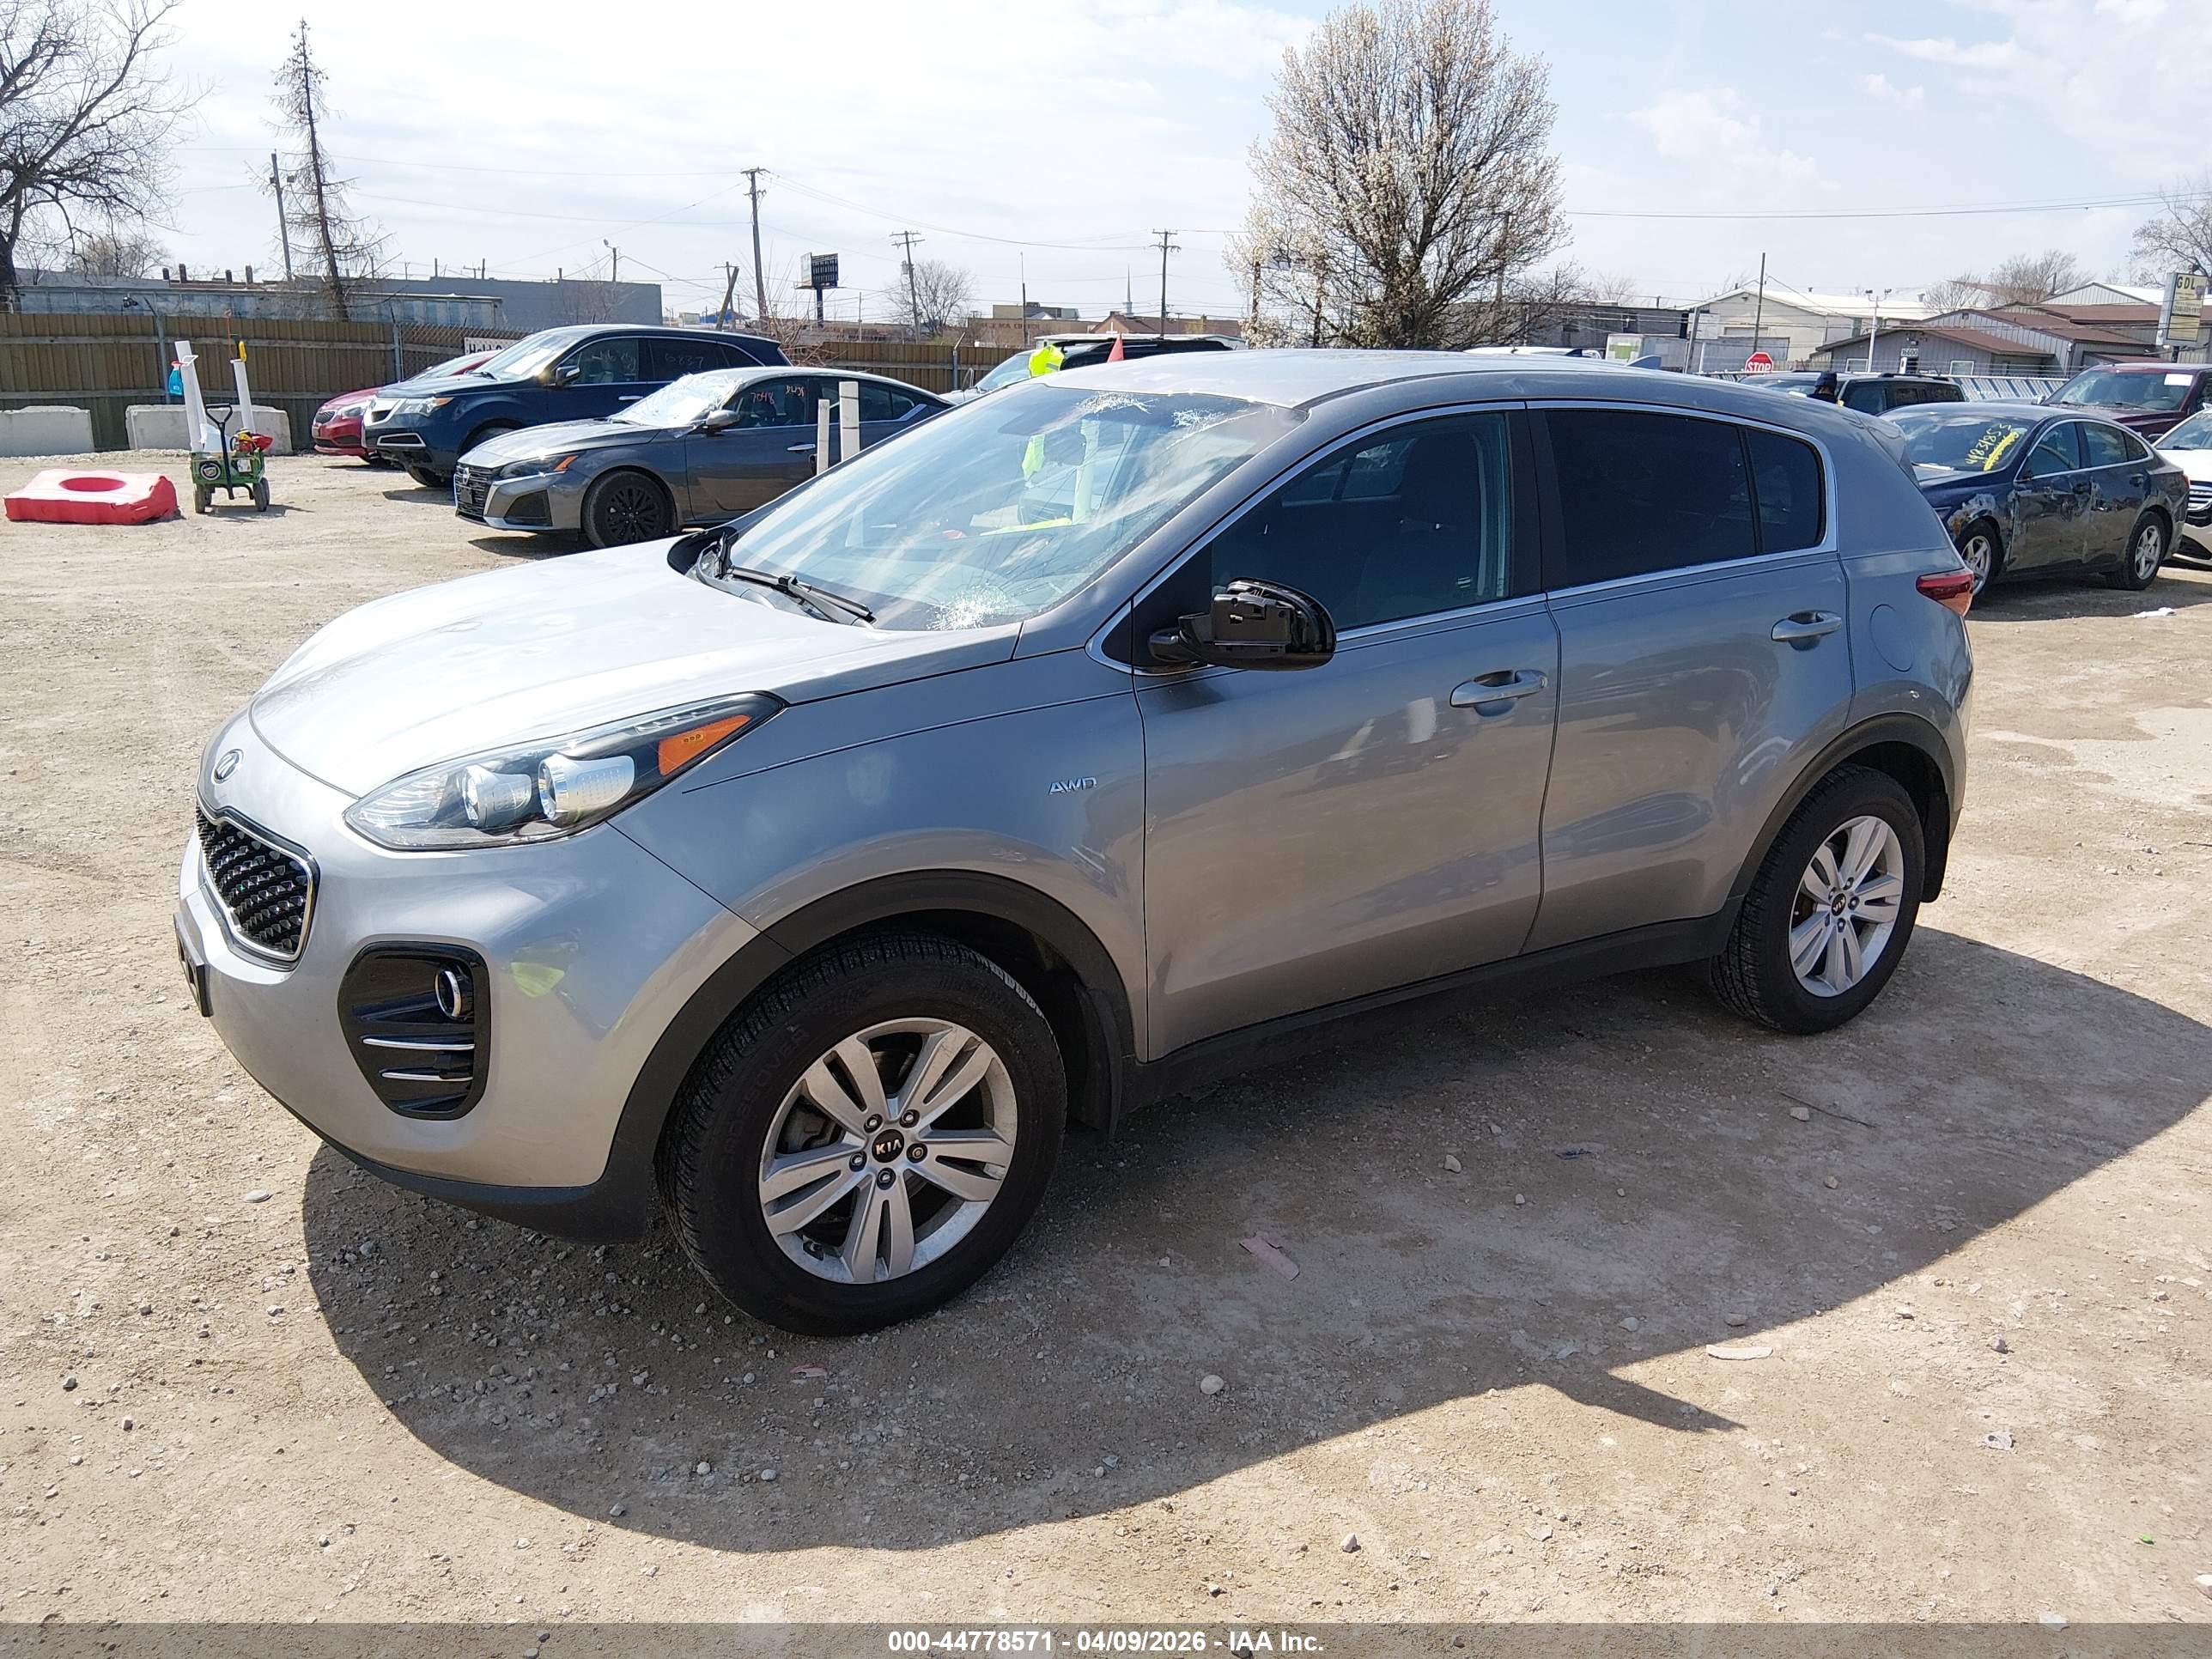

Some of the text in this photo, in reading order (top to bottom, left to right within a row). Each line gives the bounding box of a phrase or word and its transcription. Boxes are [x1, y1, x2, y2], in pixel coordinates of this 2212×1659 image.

[2177, 276, 2196, 290] GDL
[1747, 362, 1771, 372] STOP
[1048, 776, 1097, 794] AWD
[876, 1139, 902, 1155] KIA
